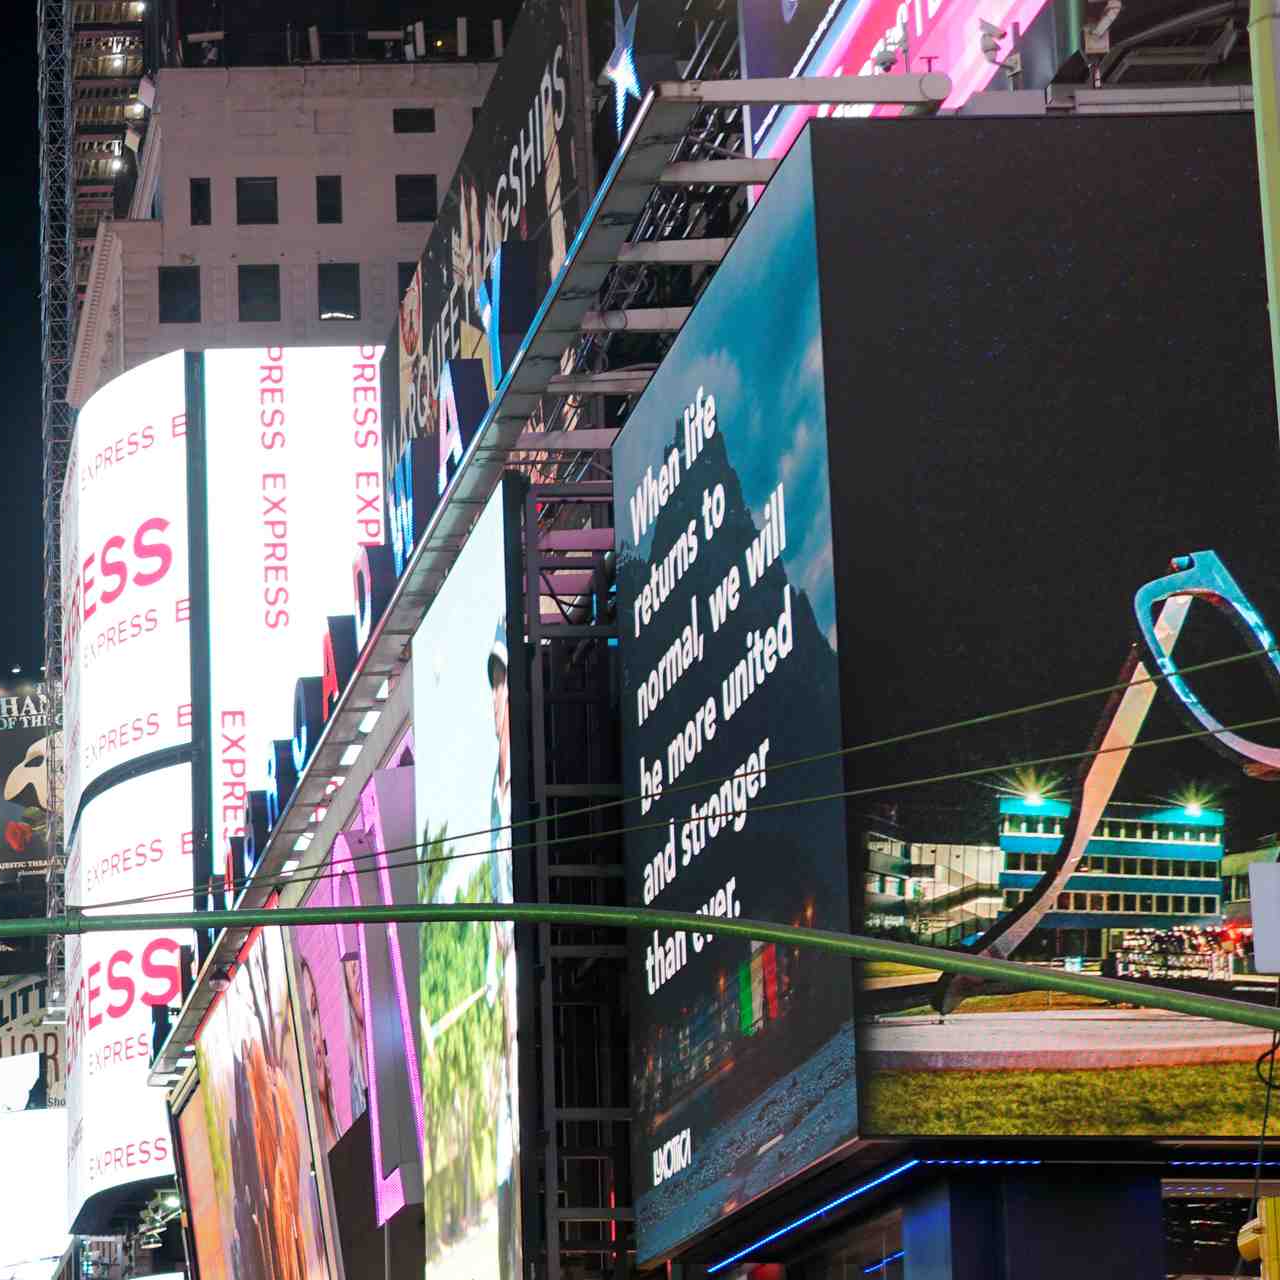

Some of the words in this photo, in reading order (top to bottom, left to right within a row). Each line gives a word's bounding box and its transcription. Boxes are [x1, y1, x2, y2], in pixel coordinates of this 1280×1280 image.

[629, 442, 681, 547] When
[683, 385, 717, 471] life
[262, 473, 289, 629] EXPRESS
[633, 519, 698, 638] returns
[701, 482, 726, 541] to
[637, 595, 705, 727] normal,
[708, 564, 741, 634] we
[744, 482, 787, 588] will
[639, 756, 664, 816] be
[667, 695, 717, 785] more
[722, 584, 794, 721] united
[643, 818, 677, 906] and
[681, 737, 771, 868] stronger
[645, 928, 689, 996] than
[88, 1032, 150, 1076] EXPRES
